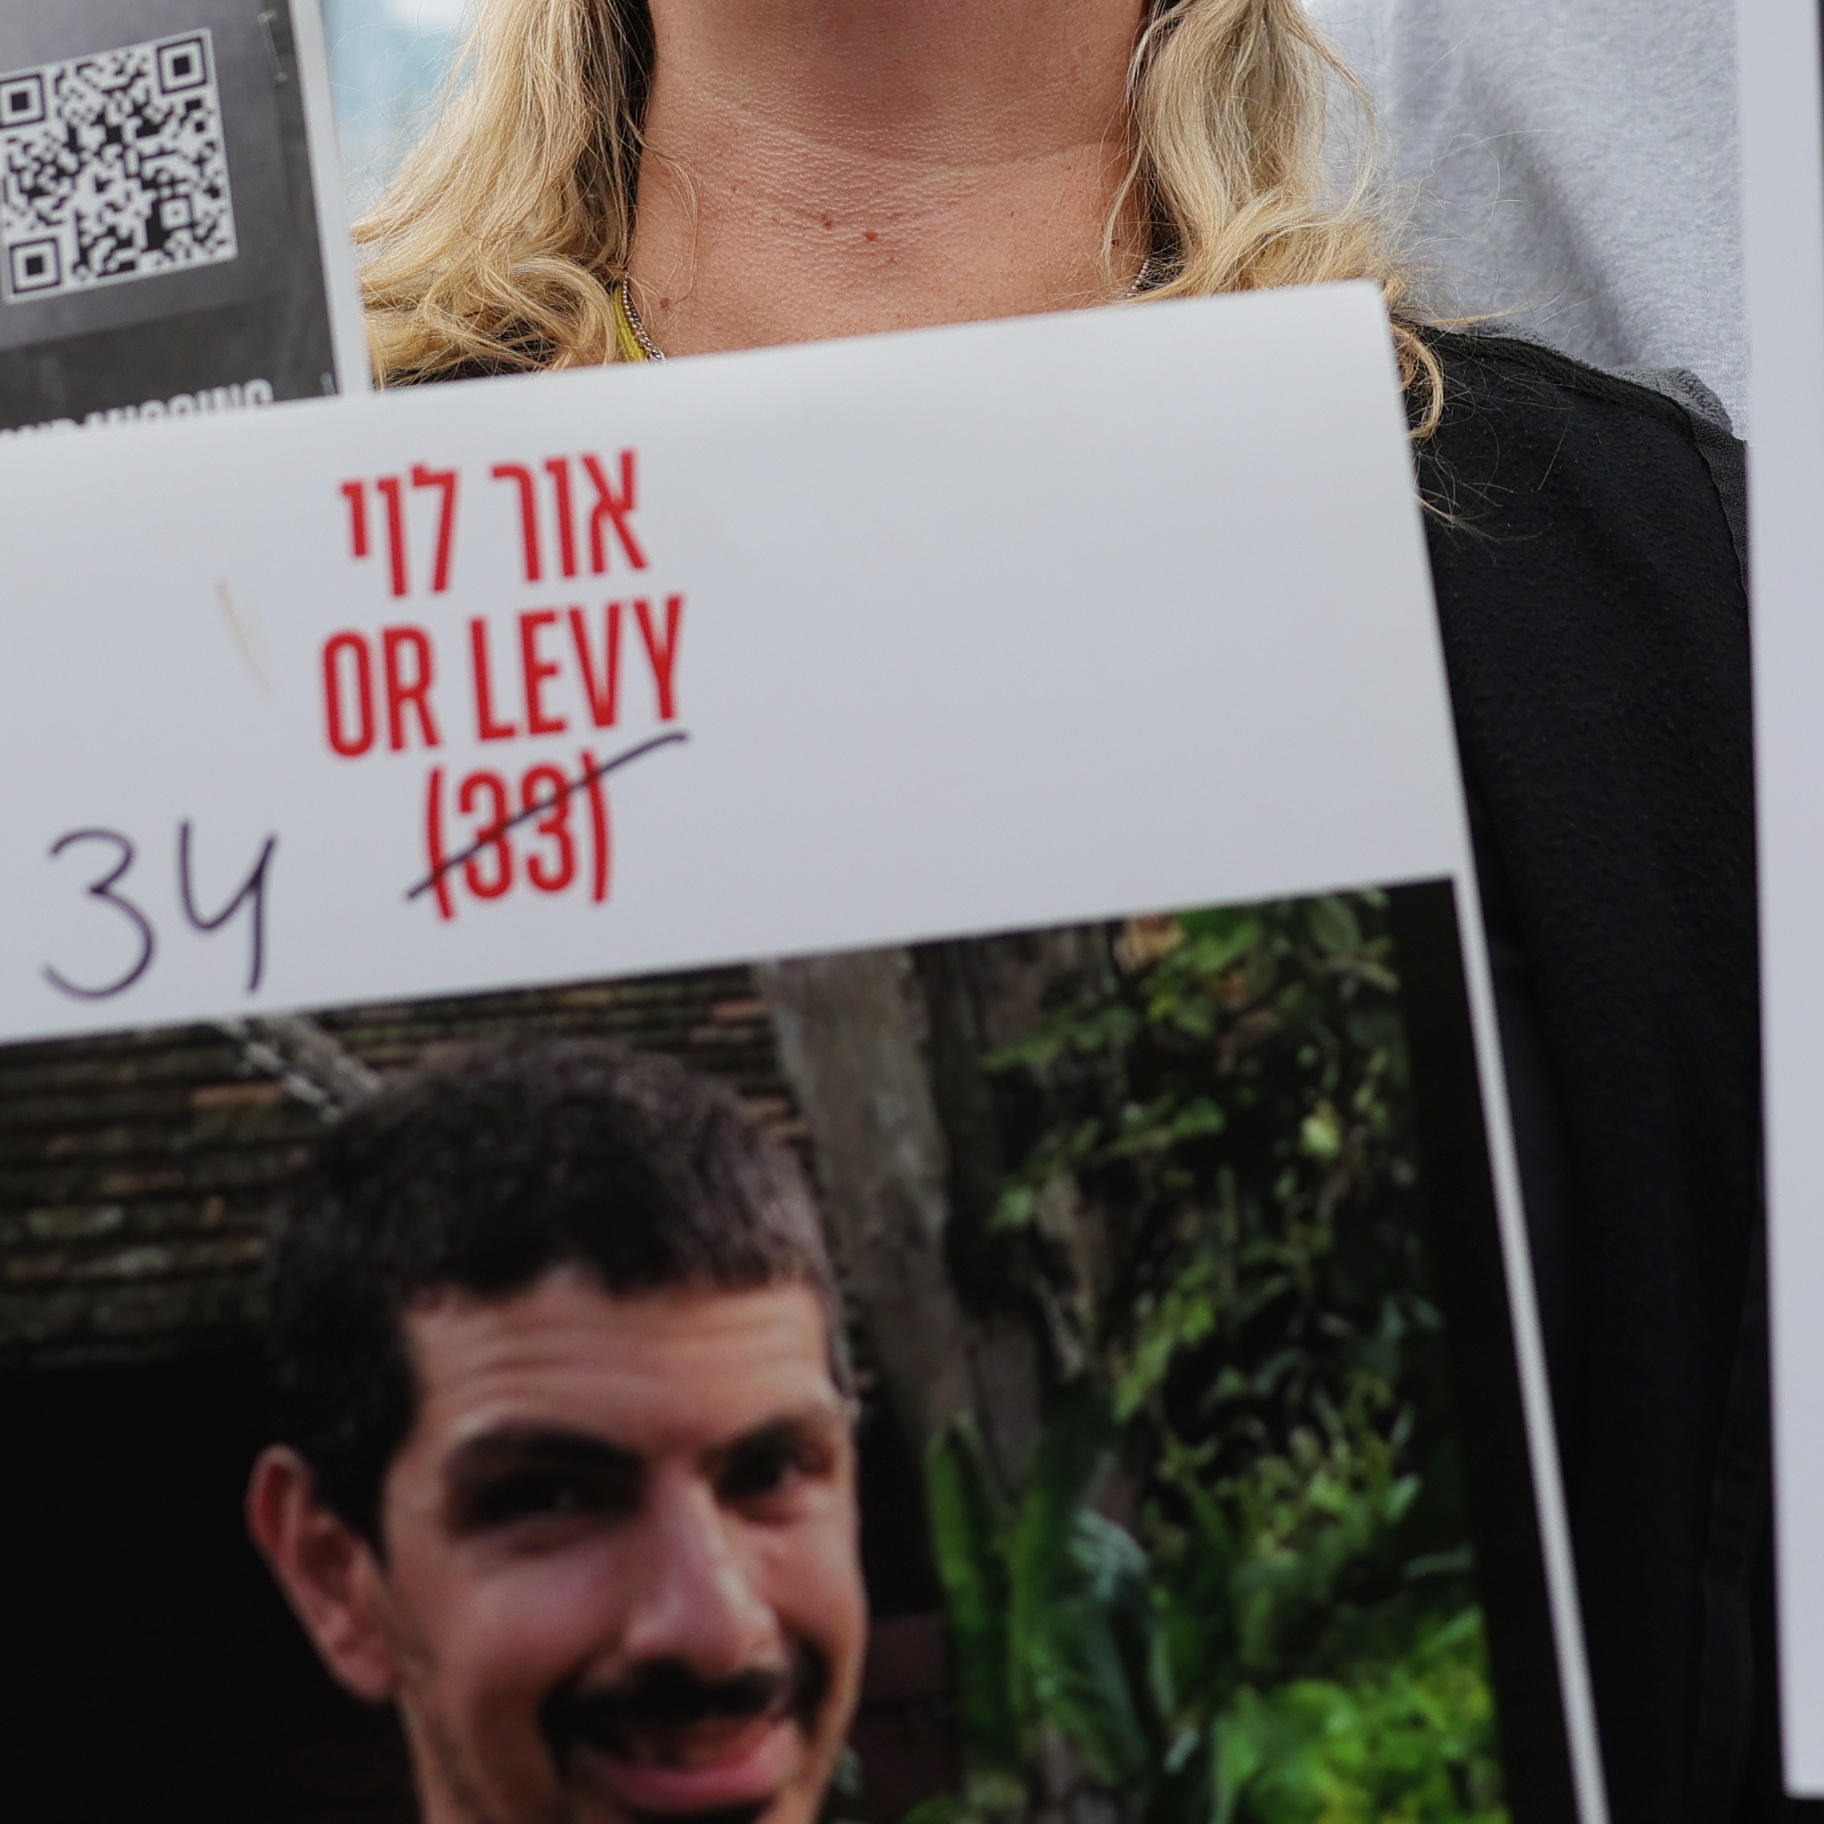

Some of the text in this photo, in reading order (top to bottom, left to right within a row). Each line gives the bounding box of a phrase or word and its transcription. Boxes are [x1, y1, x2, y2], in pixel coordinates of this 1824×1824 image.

[339, 448, 650, 599] אור לוי
[321, 594, 684, 760] OR LEVY
[42, 818, 278, 1002] 34
[424, 749, 613, 922] (33)
